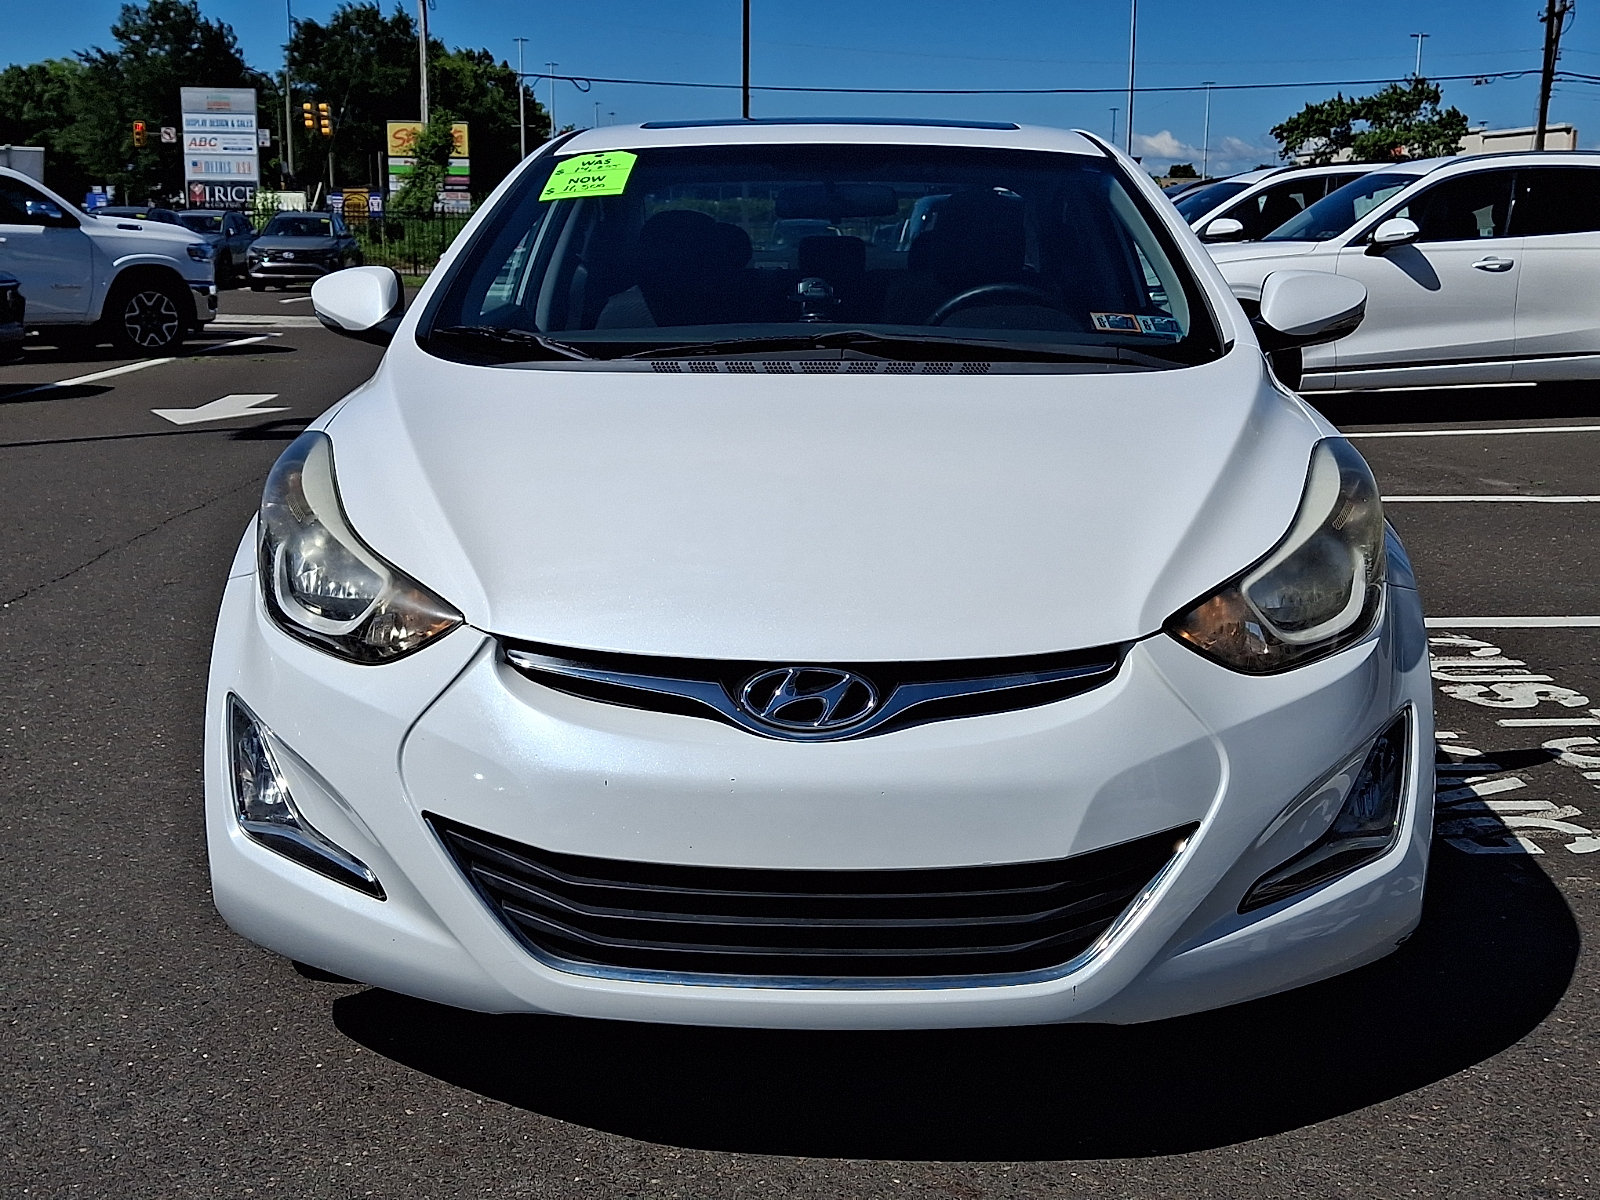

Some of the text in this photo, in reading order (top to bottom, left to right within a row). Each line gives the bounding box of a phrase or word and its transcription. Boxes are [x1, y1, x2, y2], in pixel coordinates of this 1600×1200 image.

[188, 136, 218, 146] ABC
[581, 158, 612, 167] WAS
[568, 175, 607, 185] NOW
[204, 186, 254, 202] I.RICE
